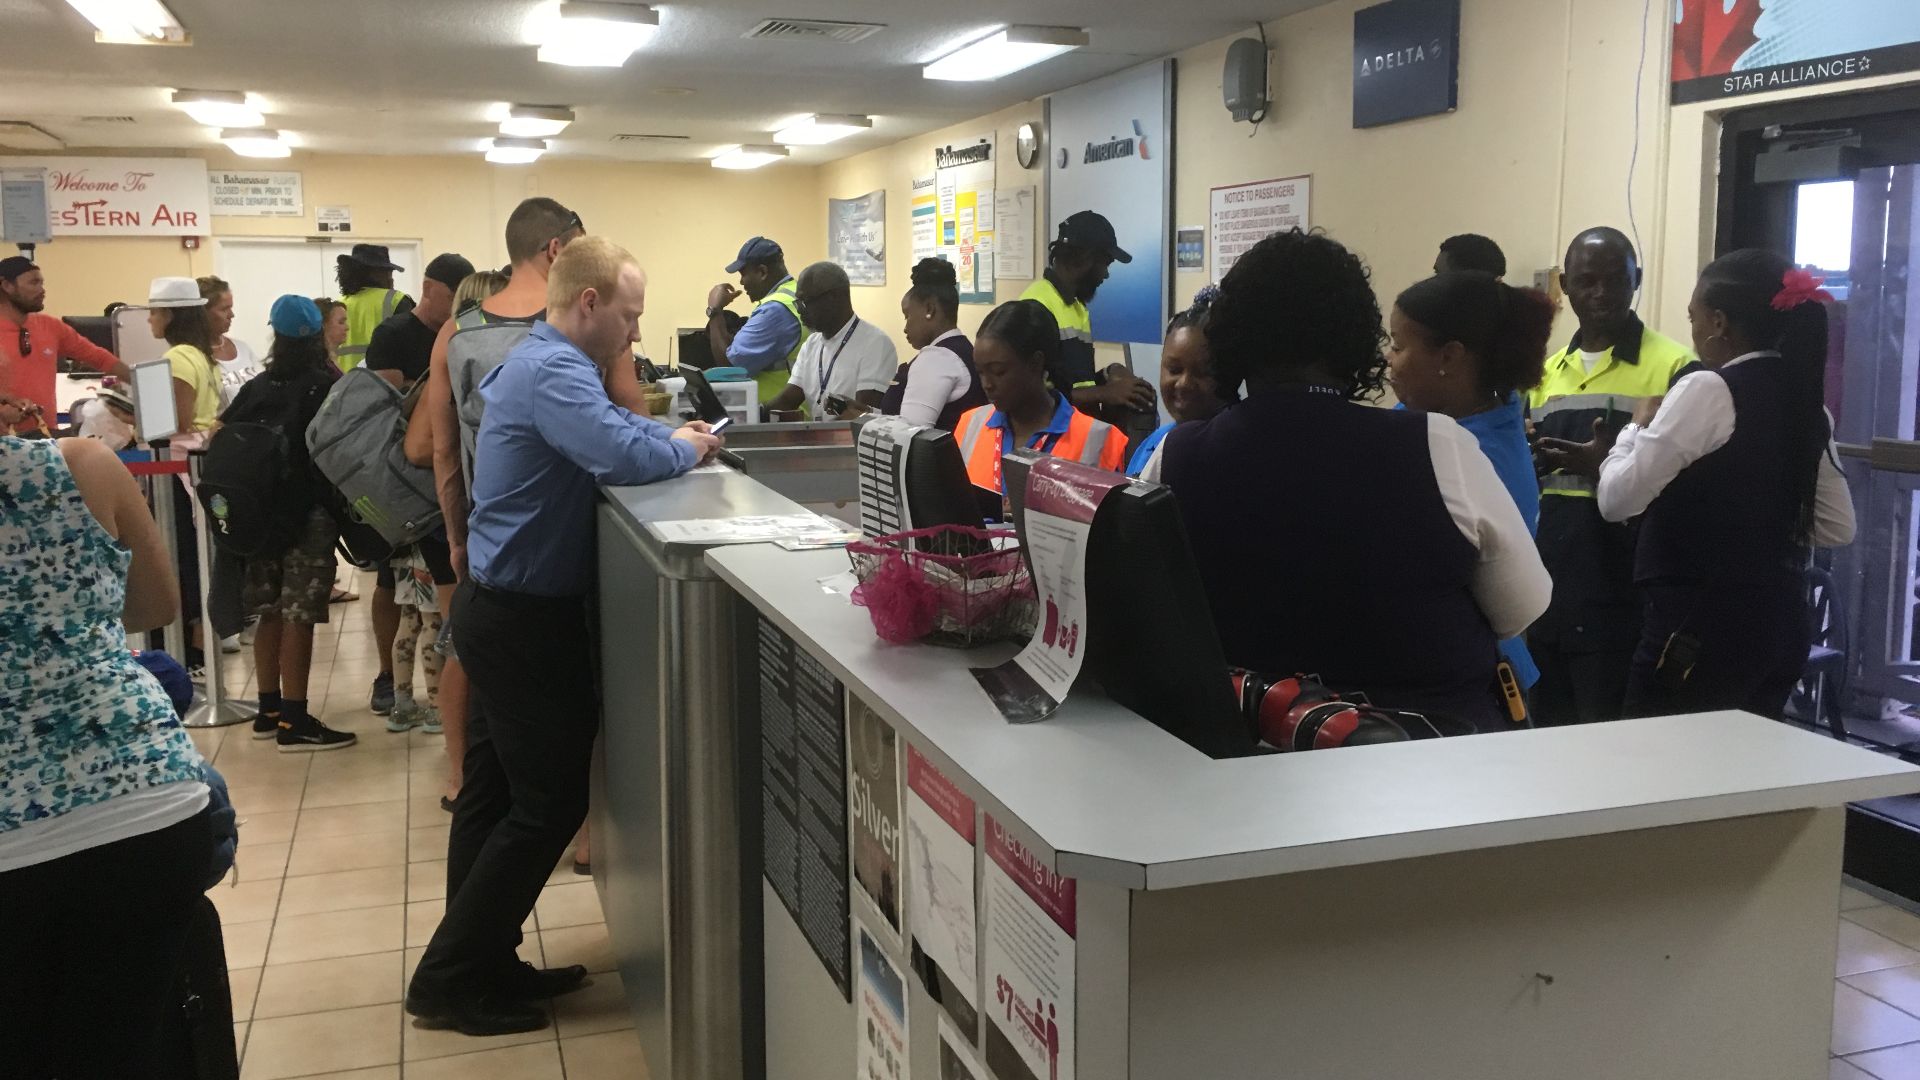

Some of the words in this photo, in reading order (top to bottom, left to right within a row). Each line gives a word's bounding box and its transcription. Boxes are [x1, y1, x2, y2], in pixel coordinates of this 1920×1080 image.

[1375, 45, 1425, 72] DELTA
[1723, 73, 1764, 92] STAR
[1768, 58, 1856, 86] ALLIANCE
[1083, 135, 1134, 164] American
[49, 169, 119, 192] Welcome
[123, 171, 154, 192] To
[1224, 191, 1245, 204] NOTICE
[1246, 190, 1254, 201] TO
[1254, 184, 1295, 201] PASSENGERS
[50, 200, 140, 227] ESTERN
[152, 204, 198, 227] AIR
[853, 771, 899, 862] Silver
[996, 973, 1014, 1022] $7
